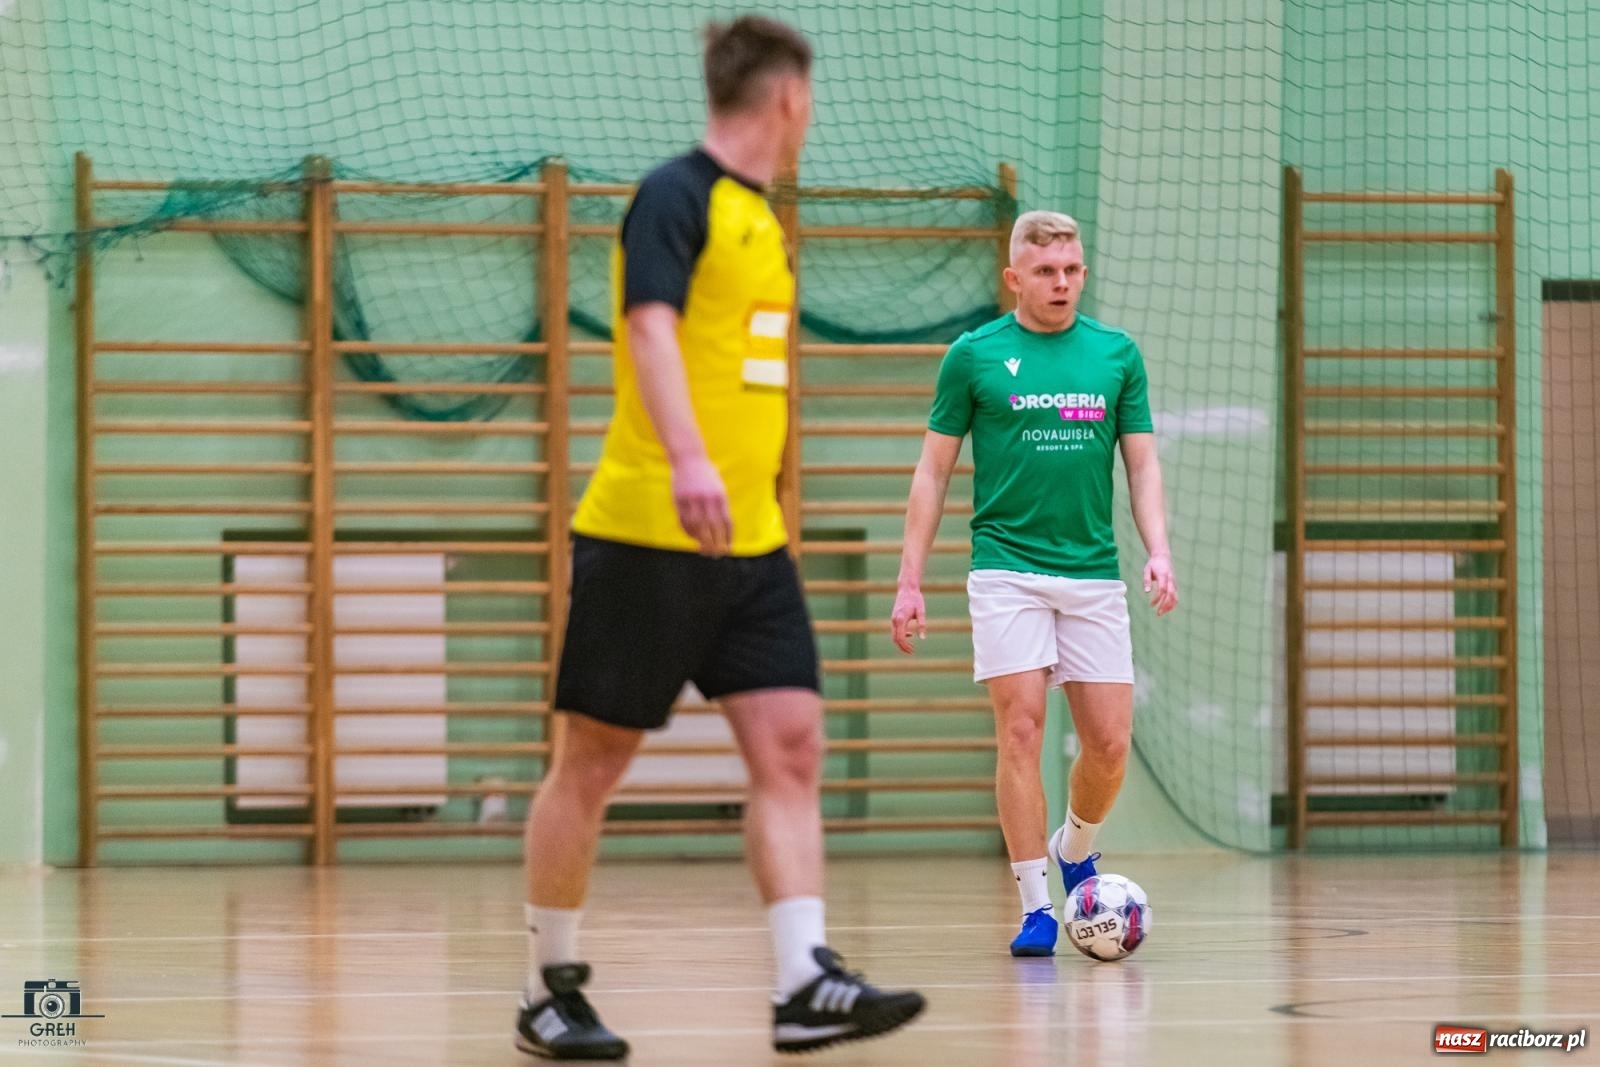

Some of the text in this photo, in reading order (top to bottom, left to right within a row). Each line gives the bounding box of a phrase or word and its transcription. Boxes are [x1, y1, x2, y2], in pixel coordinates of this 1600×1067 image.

[1010, 393, 1106, 411] DROGERIA
[1064, 410, 1074, 418] W
[1076, 918, 1118, 940] SELECT
